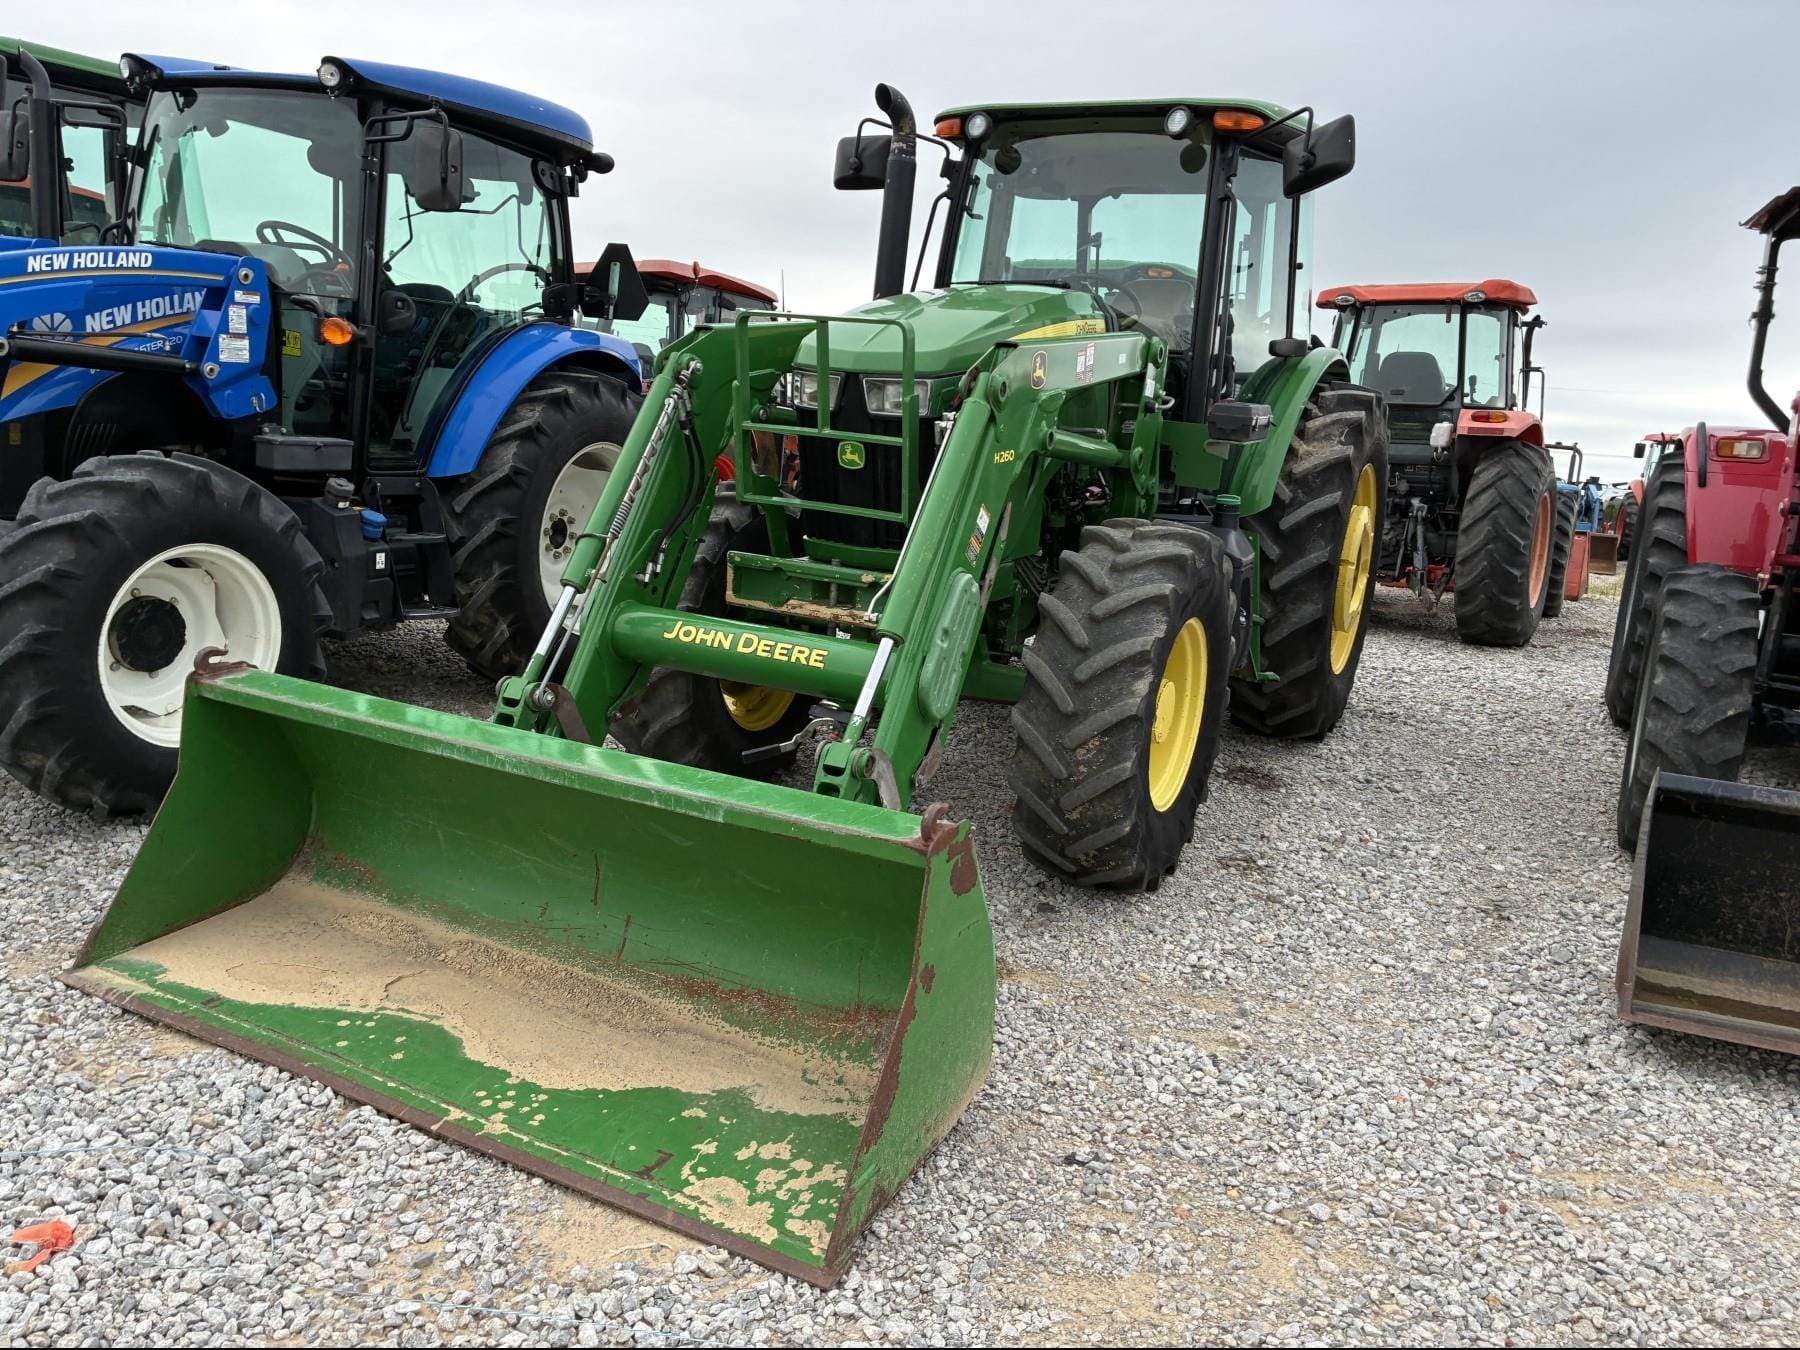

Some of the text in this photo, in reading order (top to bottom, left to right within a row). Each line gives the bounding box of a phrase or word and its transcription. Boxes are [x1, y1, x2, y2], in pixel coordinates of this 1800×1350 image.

[27, 251, 153, 273] NEW HOLLAND
[84, 303, 133, 333] NEW
[136, 288, 208, 321] HOLLAN
[994, 449, 1015, 465] H260
[663, 620, 829, 670] JOHN DEERE
